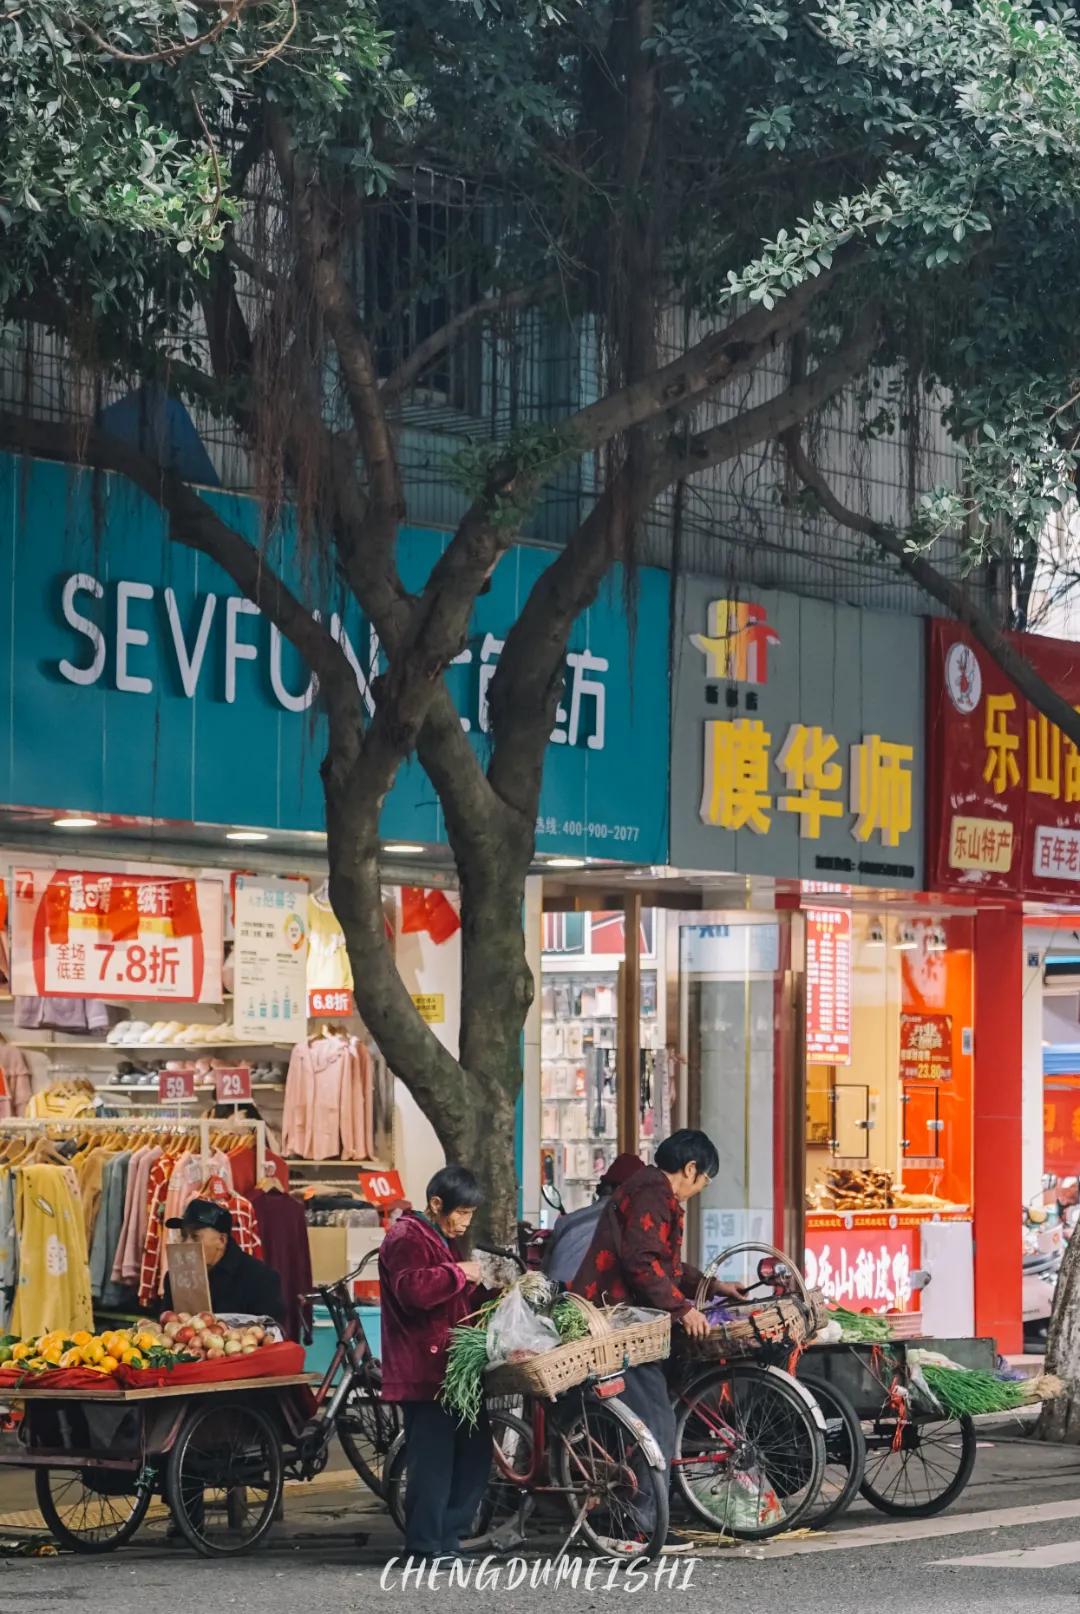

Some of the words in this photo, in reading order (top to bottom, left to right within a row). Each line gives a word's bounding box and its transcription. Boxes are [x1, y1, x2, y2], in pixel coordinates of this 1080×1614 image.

[982, 692, 1080, 804] 乐山
[700, 718, 915, 848] 膜华师
[953, 825, 1011, 864] 乐山特产
[56, 943, 86, 961] 全场
[56, 962, 86, 981] 低至
[94, 944, 180, 985] 7.8折
[312, 992, 350, 1012] 6.8折
